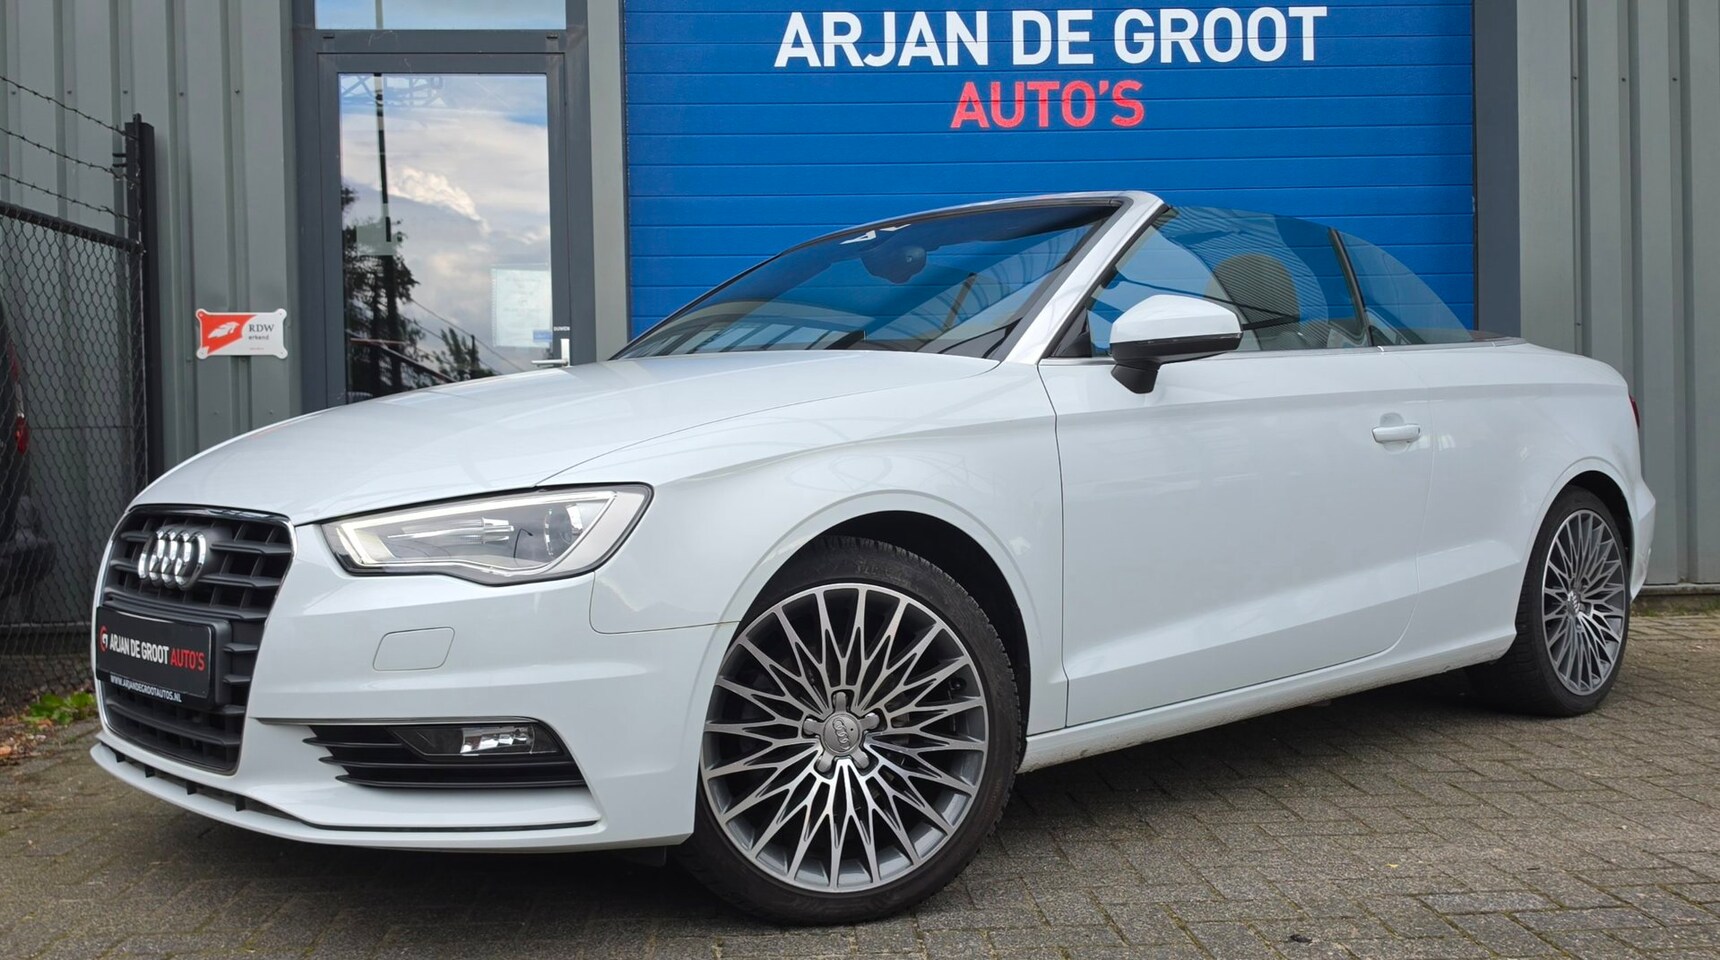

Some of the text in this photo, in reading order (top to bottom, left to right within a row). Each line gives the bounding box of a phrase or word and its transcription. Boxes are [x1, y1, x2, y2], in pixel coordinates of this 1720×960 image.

[774, 6, 1328, 68] ARJAN DE GROOT
[950, 80, 1145, 129] AUTO'S
[248, 324, 275, 332] RDW
[109, 633, 206, 672] ARJAN DE GROOT AUTO'S
